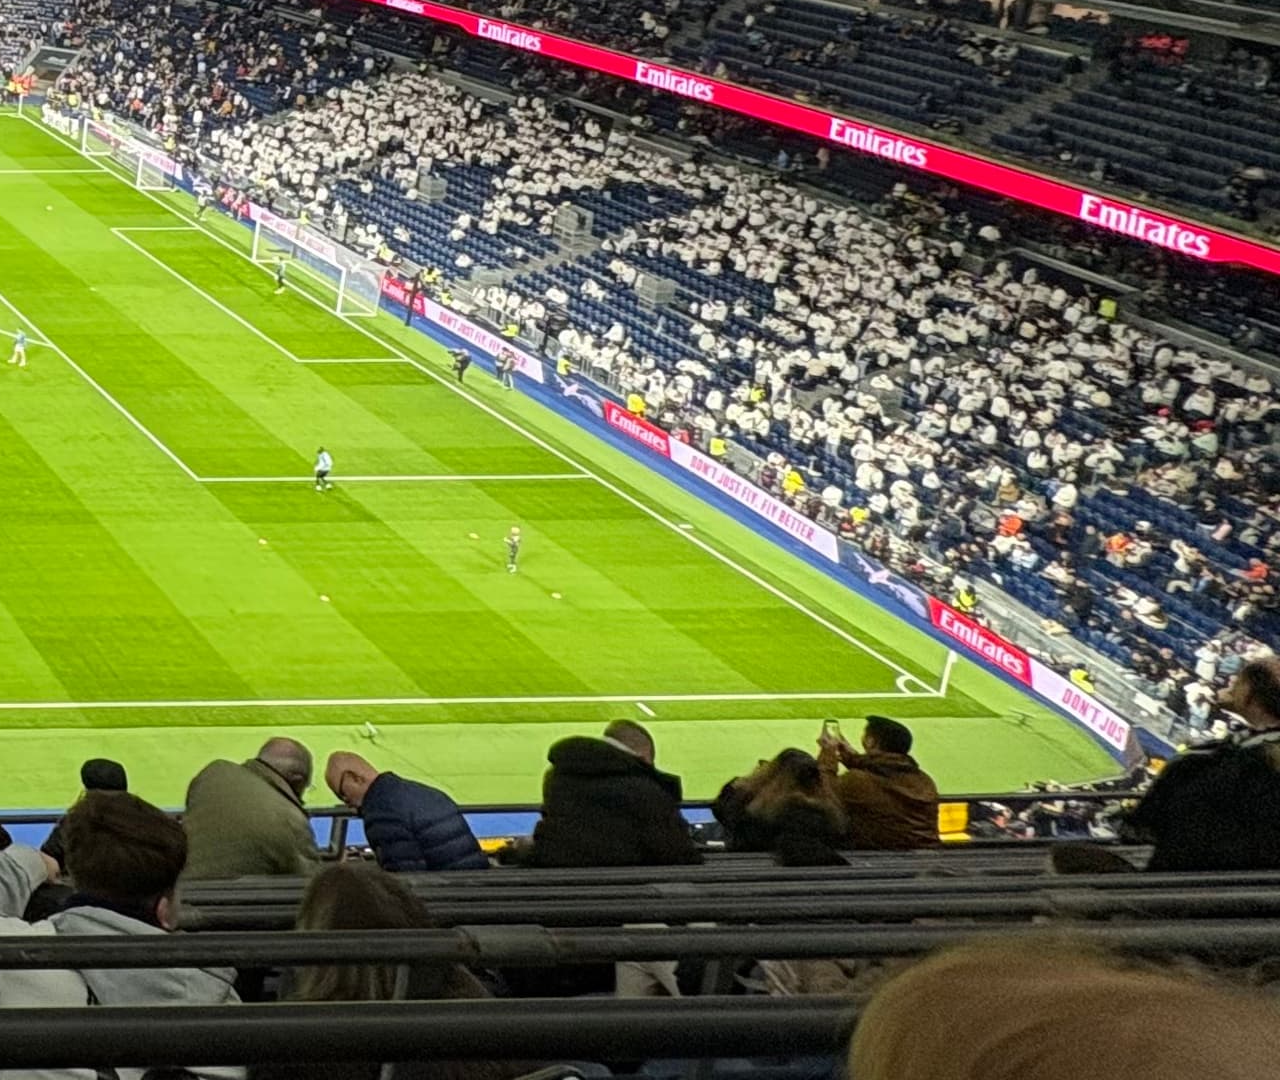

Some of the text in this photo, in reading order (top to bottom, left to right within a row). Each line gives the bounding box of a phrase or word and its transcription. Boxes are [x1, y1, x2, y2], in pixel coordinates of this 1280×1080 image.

[478, 18, 541, 51] Emirates
[635, 61, 713, 101] Emirates
[829, 117, 927, 167] Emirates
[1079, 193, 1210, 258] Emirates
[610, 409, 668, 451] Emirates
[778, 509, 815, 542] BETTER
[940, 609, 1025, 675] Emirates
[1099, 717, 1126, 744] JUS
